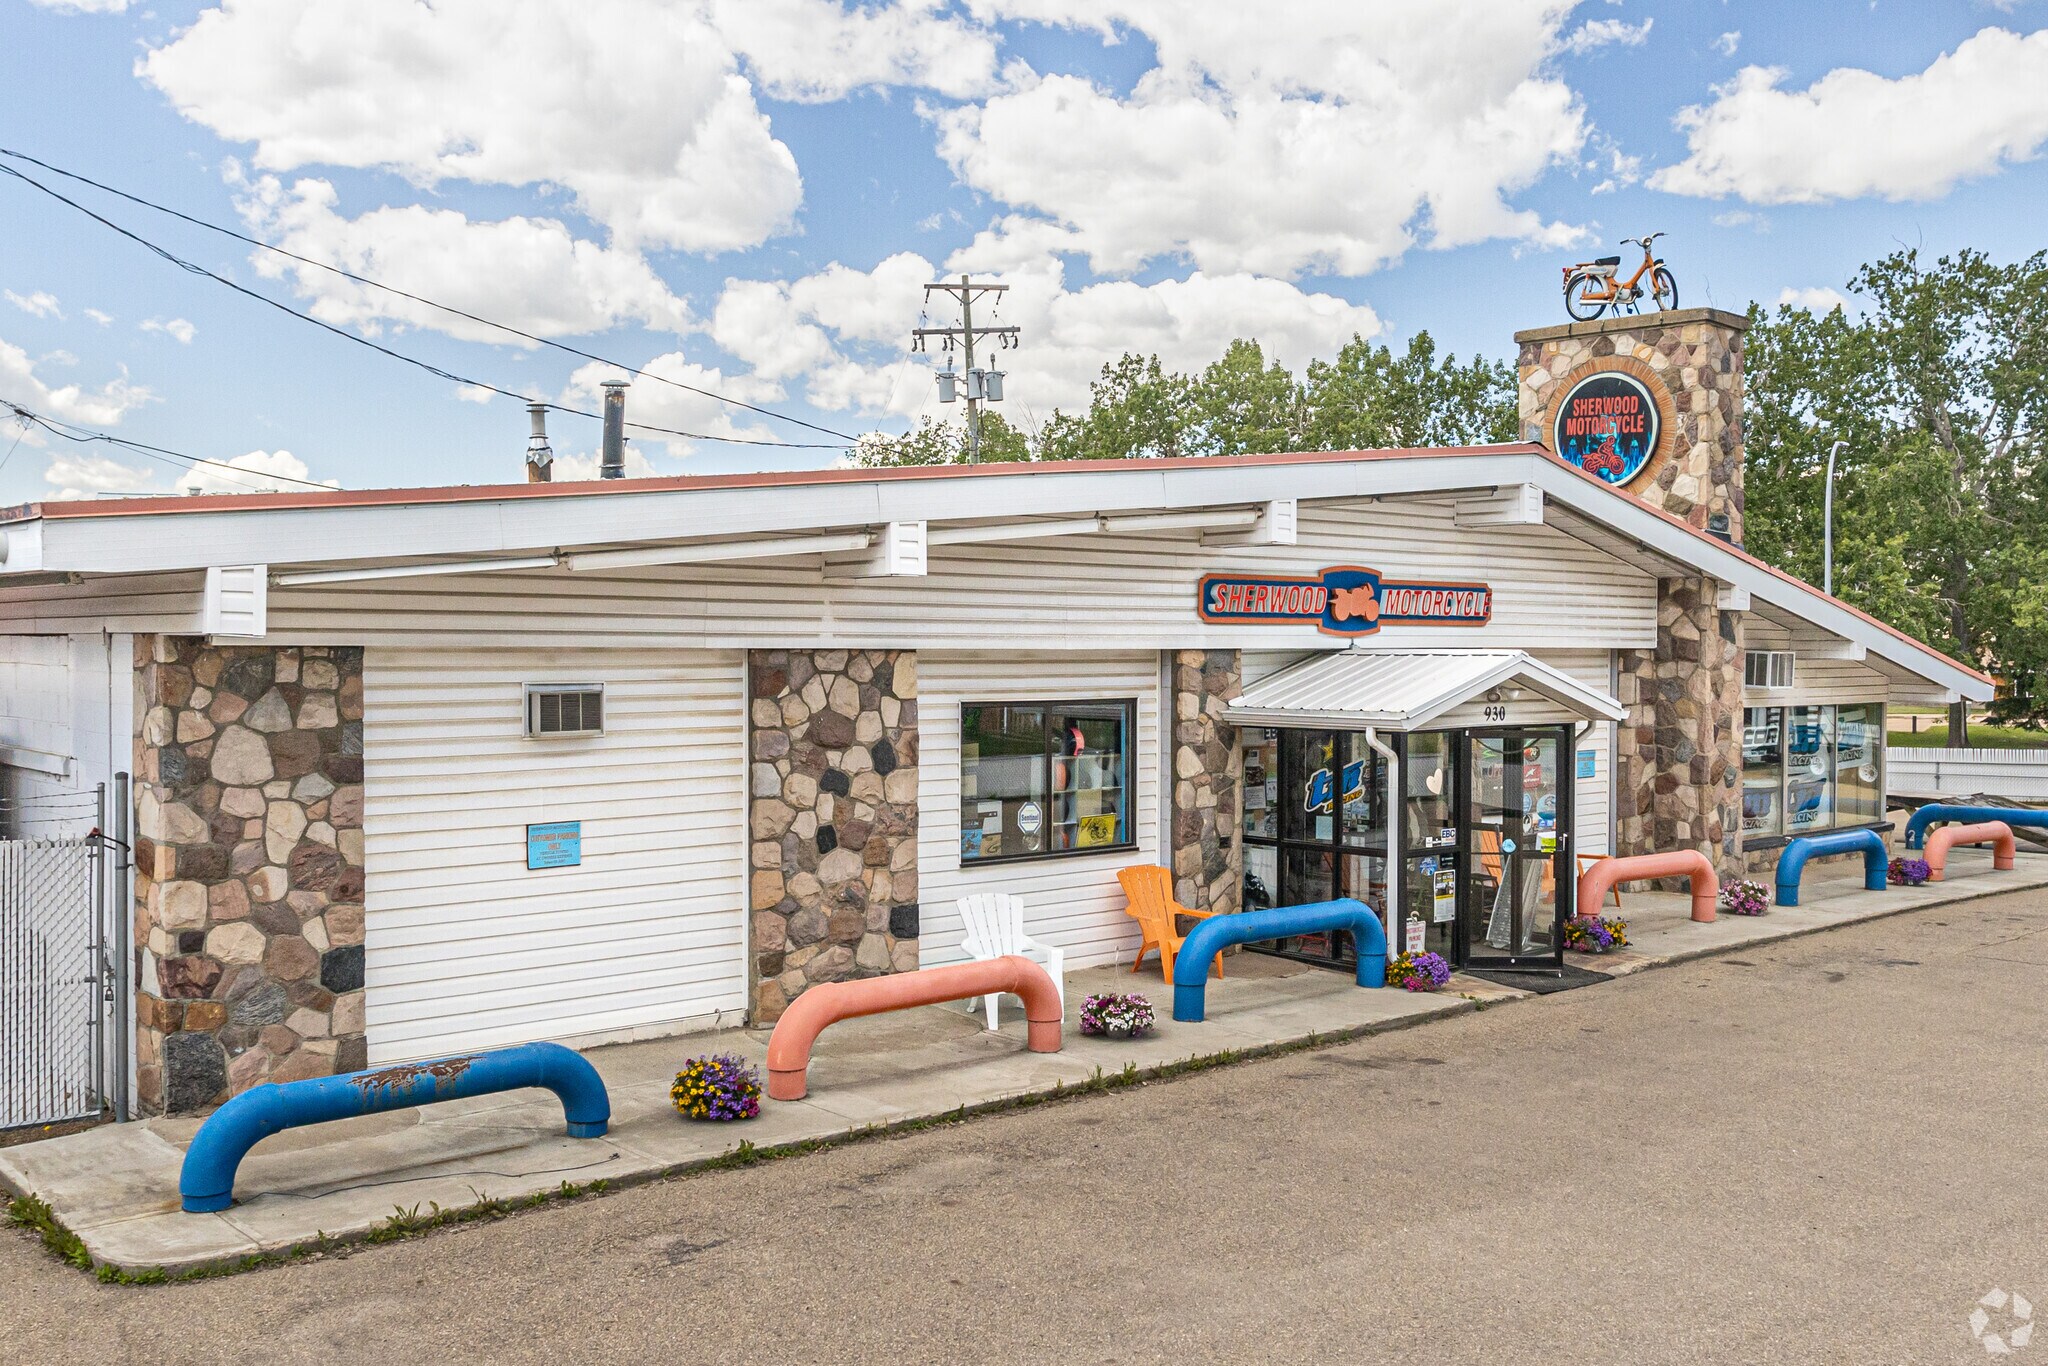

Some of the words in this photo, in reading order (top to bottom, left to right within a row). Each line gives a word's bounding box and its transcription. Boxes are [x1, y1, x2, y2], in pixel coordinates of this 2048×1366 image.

[1573, 395, 1639, 416] SHERWOOD
[1566, 414, 1644, 435] MOTORCYCLE
[1209, 583, 1328, 614] SHERWOOD
[1383, 589, 1492, 616] MOTORCYCLE
[1484, 706, 1506, 722] 930
[1326, 788, 1363, 811] RCING
[1441, 829, 1456, 839] EBC
